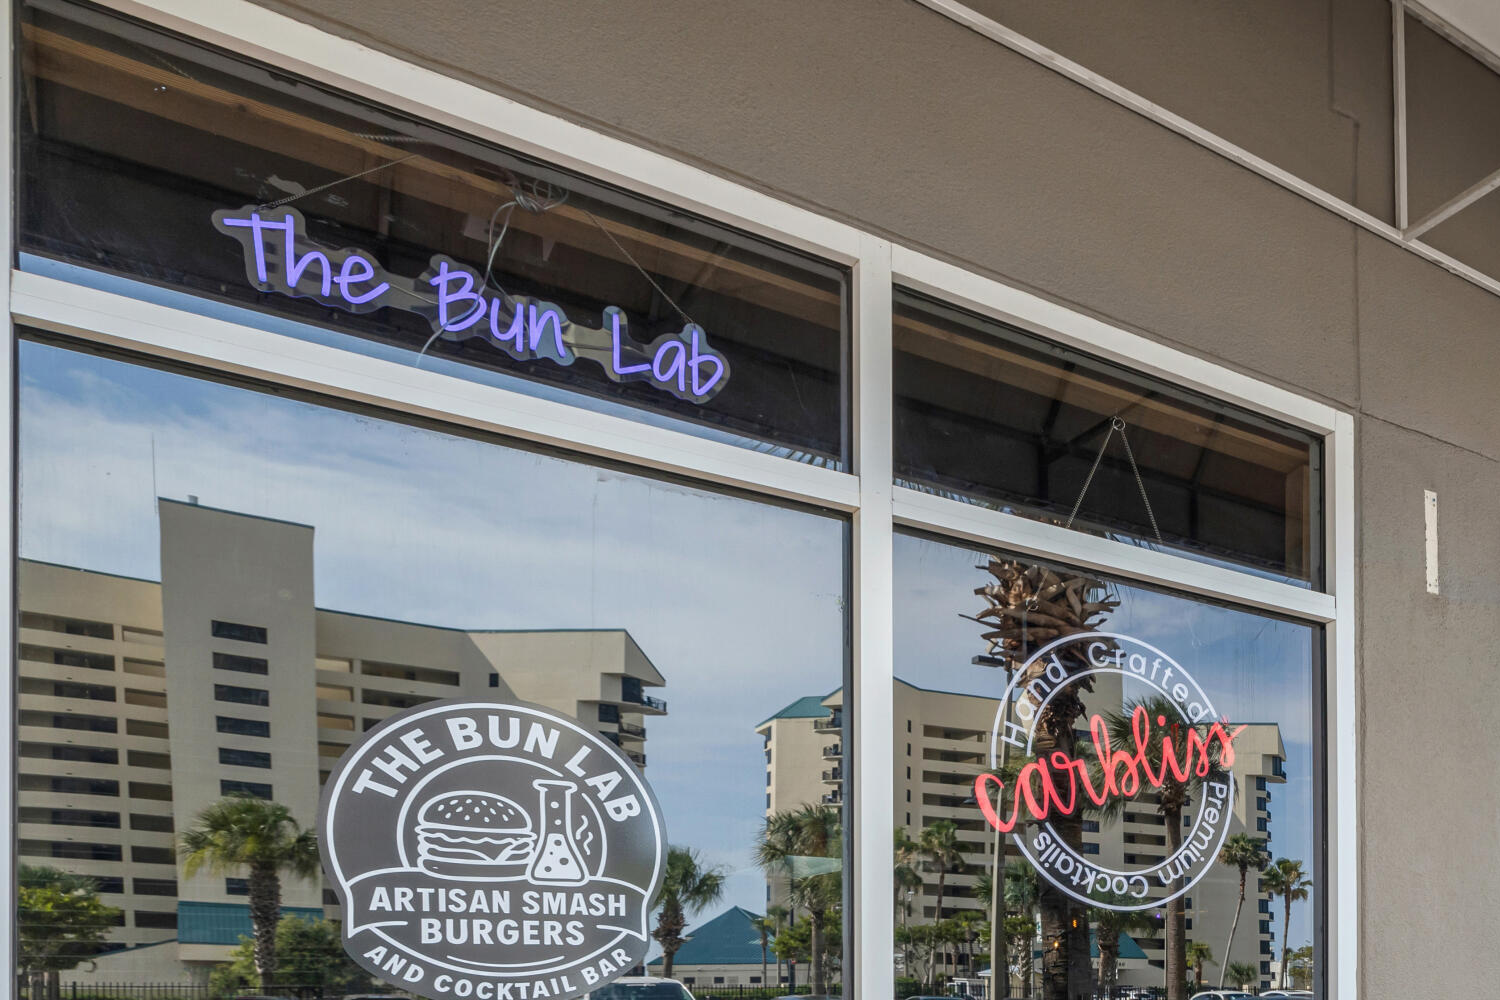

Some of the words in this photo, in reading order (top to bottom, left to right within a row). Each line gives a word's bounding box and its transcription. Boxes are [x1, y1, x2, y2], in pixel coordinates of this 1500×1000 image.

[222, 213, 390, 304] The
[429, 260, 567, 358] Bun
[612, 312, 724, 396] Lab
[1001, 653, 1067, 748] Hand
[1087, 641, 1209, 723] Crafted
[352, 727, 445, 798] THE
[446, 714, 560, 759] BUN
[565, 745, 641, 822] LAB
[1033, 831, 1149, 899] Cocktails
[1158, 780, 1228, 885] Premium
[368, 886, 510, 914] ARTISAN
[522, 891, 626, 917] SMASH
[420, 918, 585, 946] BURGERS
[363, 945, 425, 983] AND
[433, 974, 577, 1000] COCKTAIL
[581, 948, 632, 986] BAR
